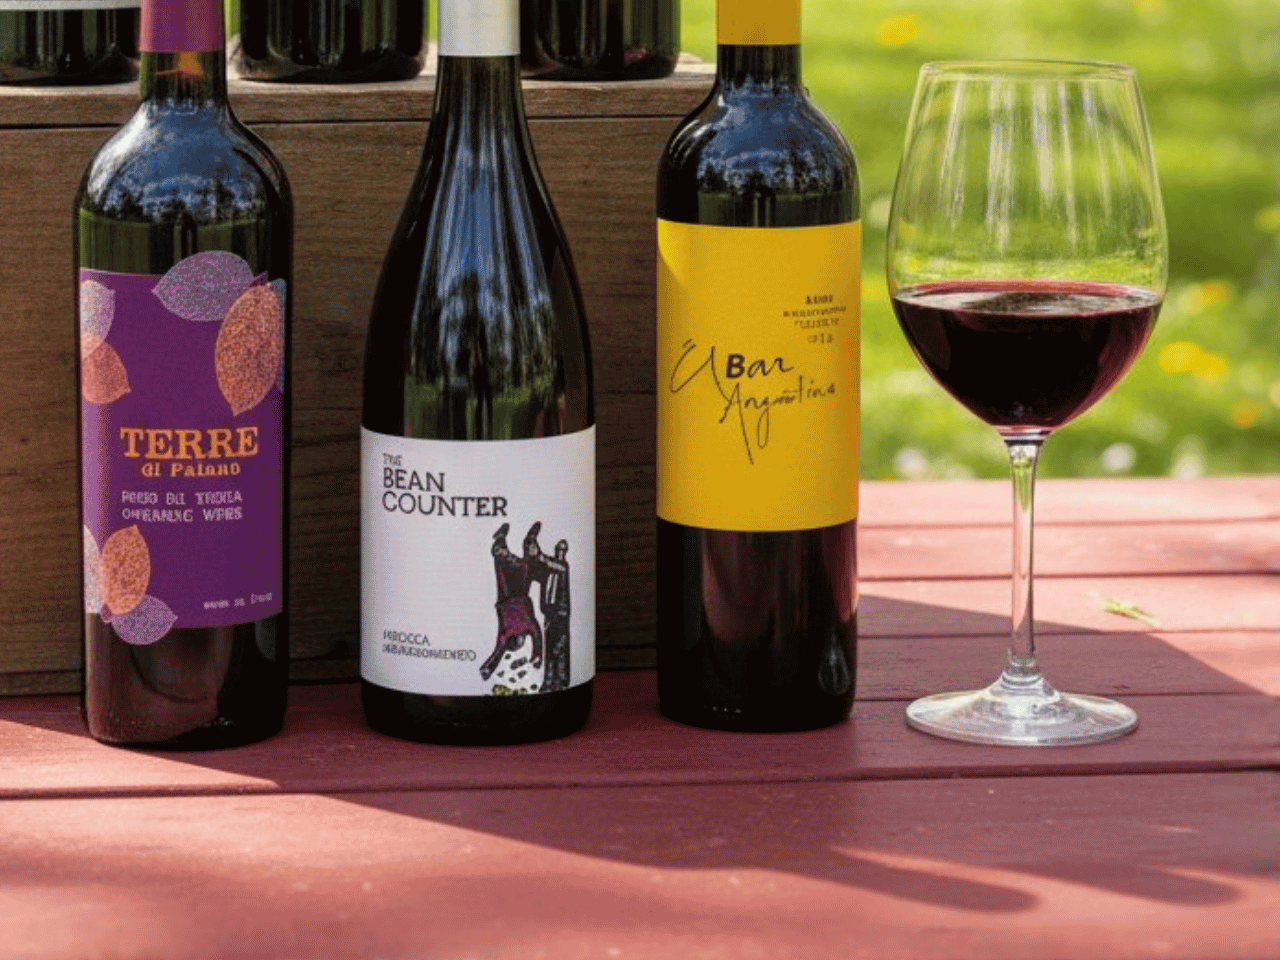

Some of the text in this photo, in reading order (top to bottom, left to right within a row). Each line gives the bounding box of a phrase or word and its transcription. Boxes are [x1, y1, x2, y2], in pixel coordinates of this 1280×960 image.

[725, 353, 795, 379] Bar
[120, 426, 259, 459] TERRE
[383, 466, 446, 493] BEAN
[381, 490, 509, 518] COUNTER
